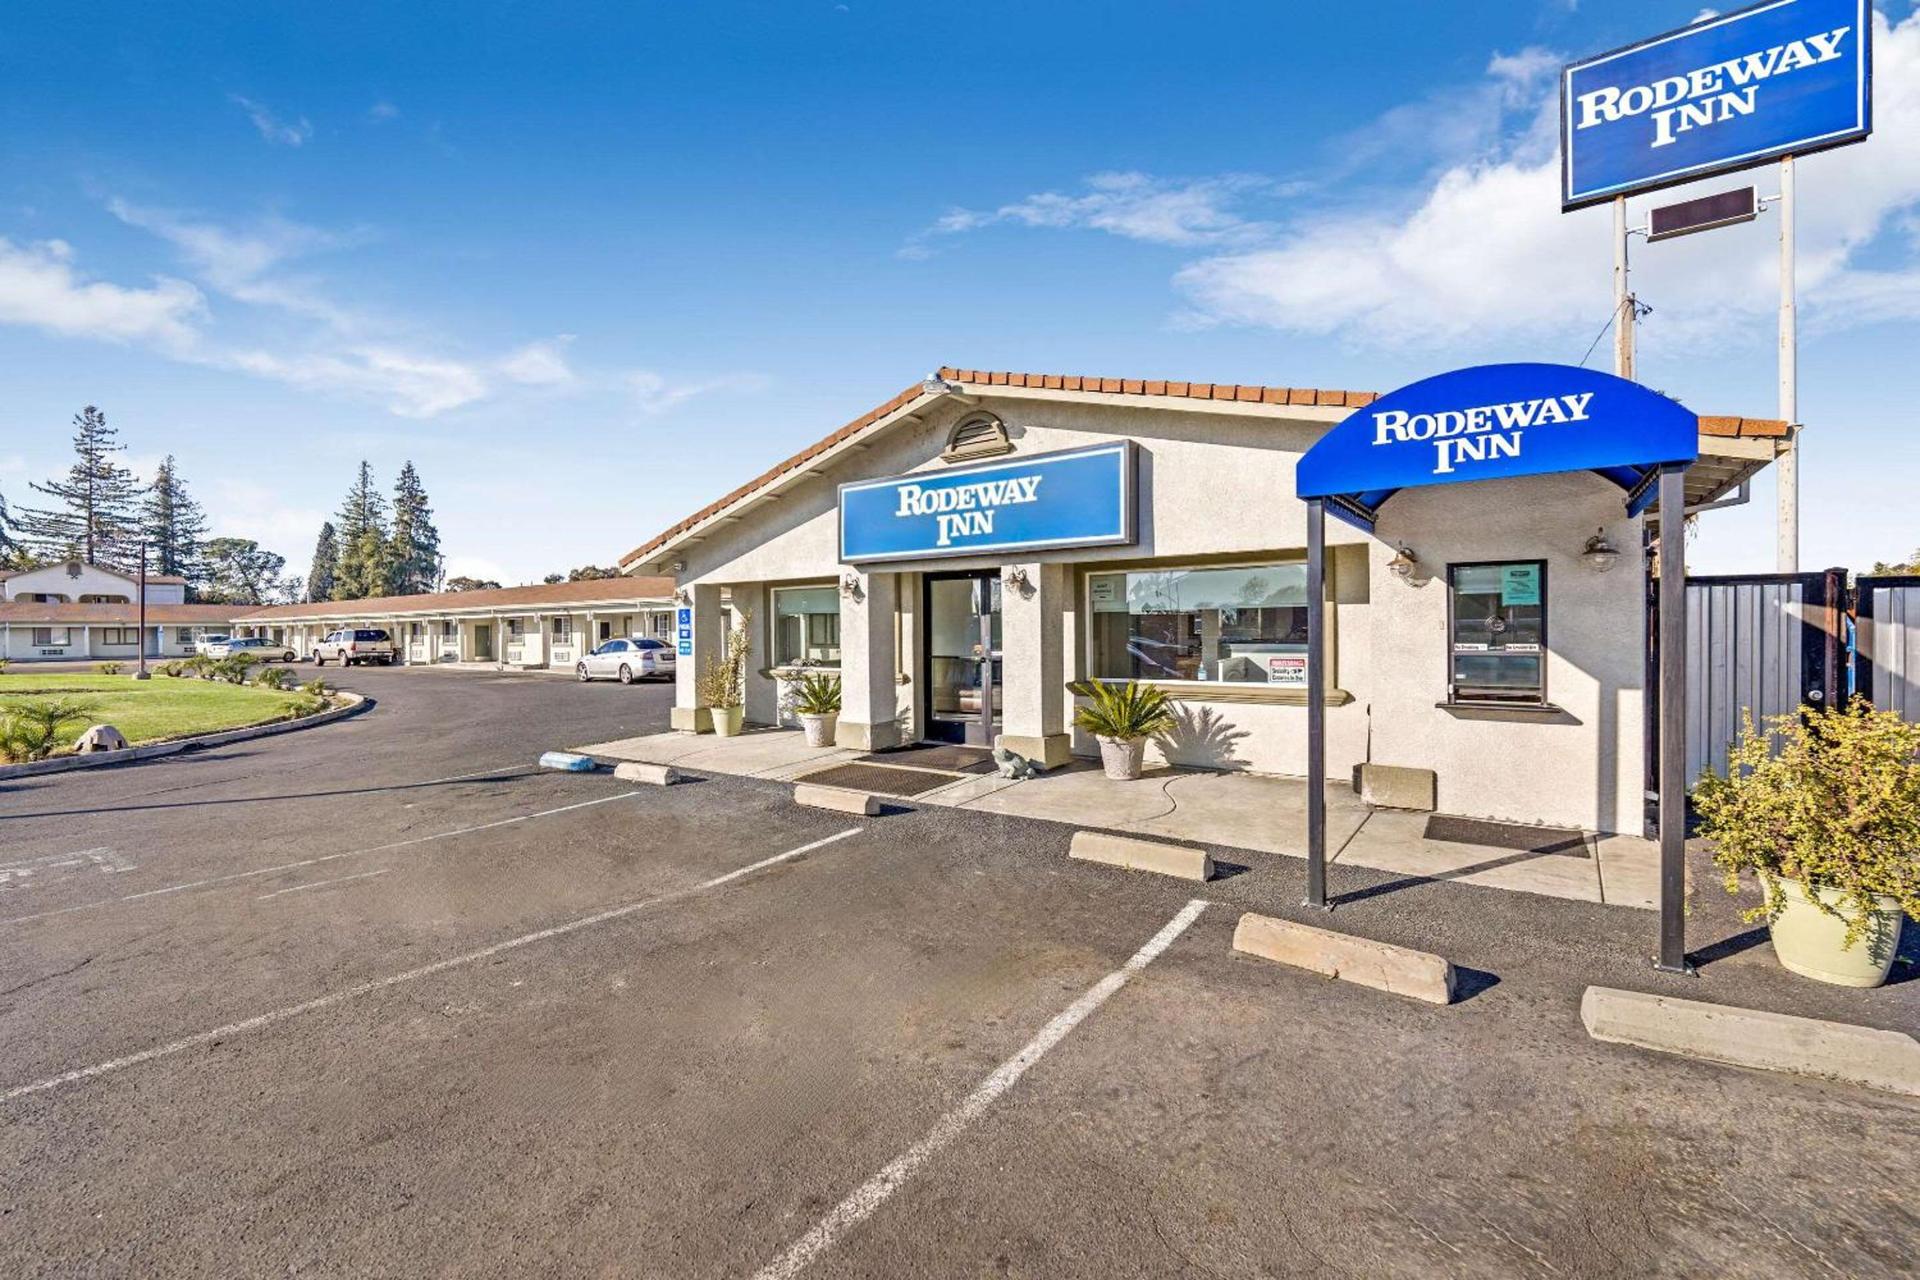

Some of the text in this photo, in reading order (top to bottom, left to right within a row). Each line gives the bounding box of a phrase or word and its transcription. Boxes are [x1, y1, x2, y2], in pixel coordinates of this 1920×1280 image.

[1577, 27, 1850, 129] RODEWAY
[1651, 86, 1759, 147] INN
[1372, 393, 1594, 445] RODEWAY
[1433, 432, 1523, 473] INN
[896, 476, 1042, 516] RODEWAY
[937, 510, 994, 545] INN
